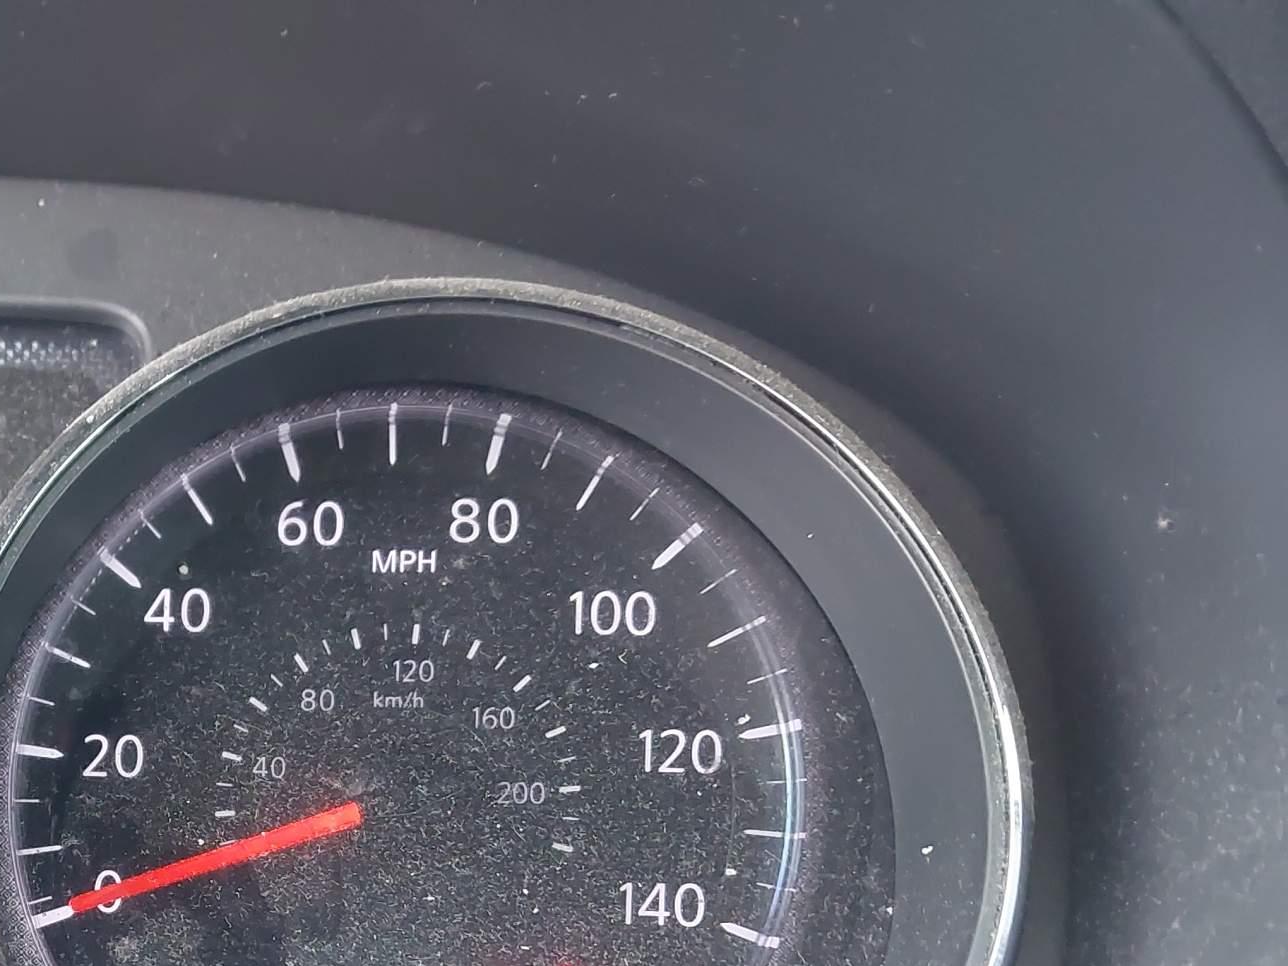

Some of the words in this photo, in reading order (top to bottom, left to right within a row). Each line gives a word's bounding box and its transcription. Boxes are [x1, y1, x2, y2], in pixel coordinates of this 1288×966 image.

[277, 500, 345, 547] 60
[448, 497, 520, 545] 80
[371, 549, 437, 574] MPH
[143, 586, 212, 633] 40
[569, 589, 657, 637] 100
[392, 659, 436, 683] 120
[300, 688, 336, 712] 80
[372, 690, 425, 709] km/h
[472, 706, 516, 730] 160
[81, 733, 145, 779] 20
[252, 756, 287, 780] 40
[638, 728, 723, 775] 120
[497, 781, 546, 806] 200
[94, 869, 123, 914] 0
[619, 881, 706, 928] 140
